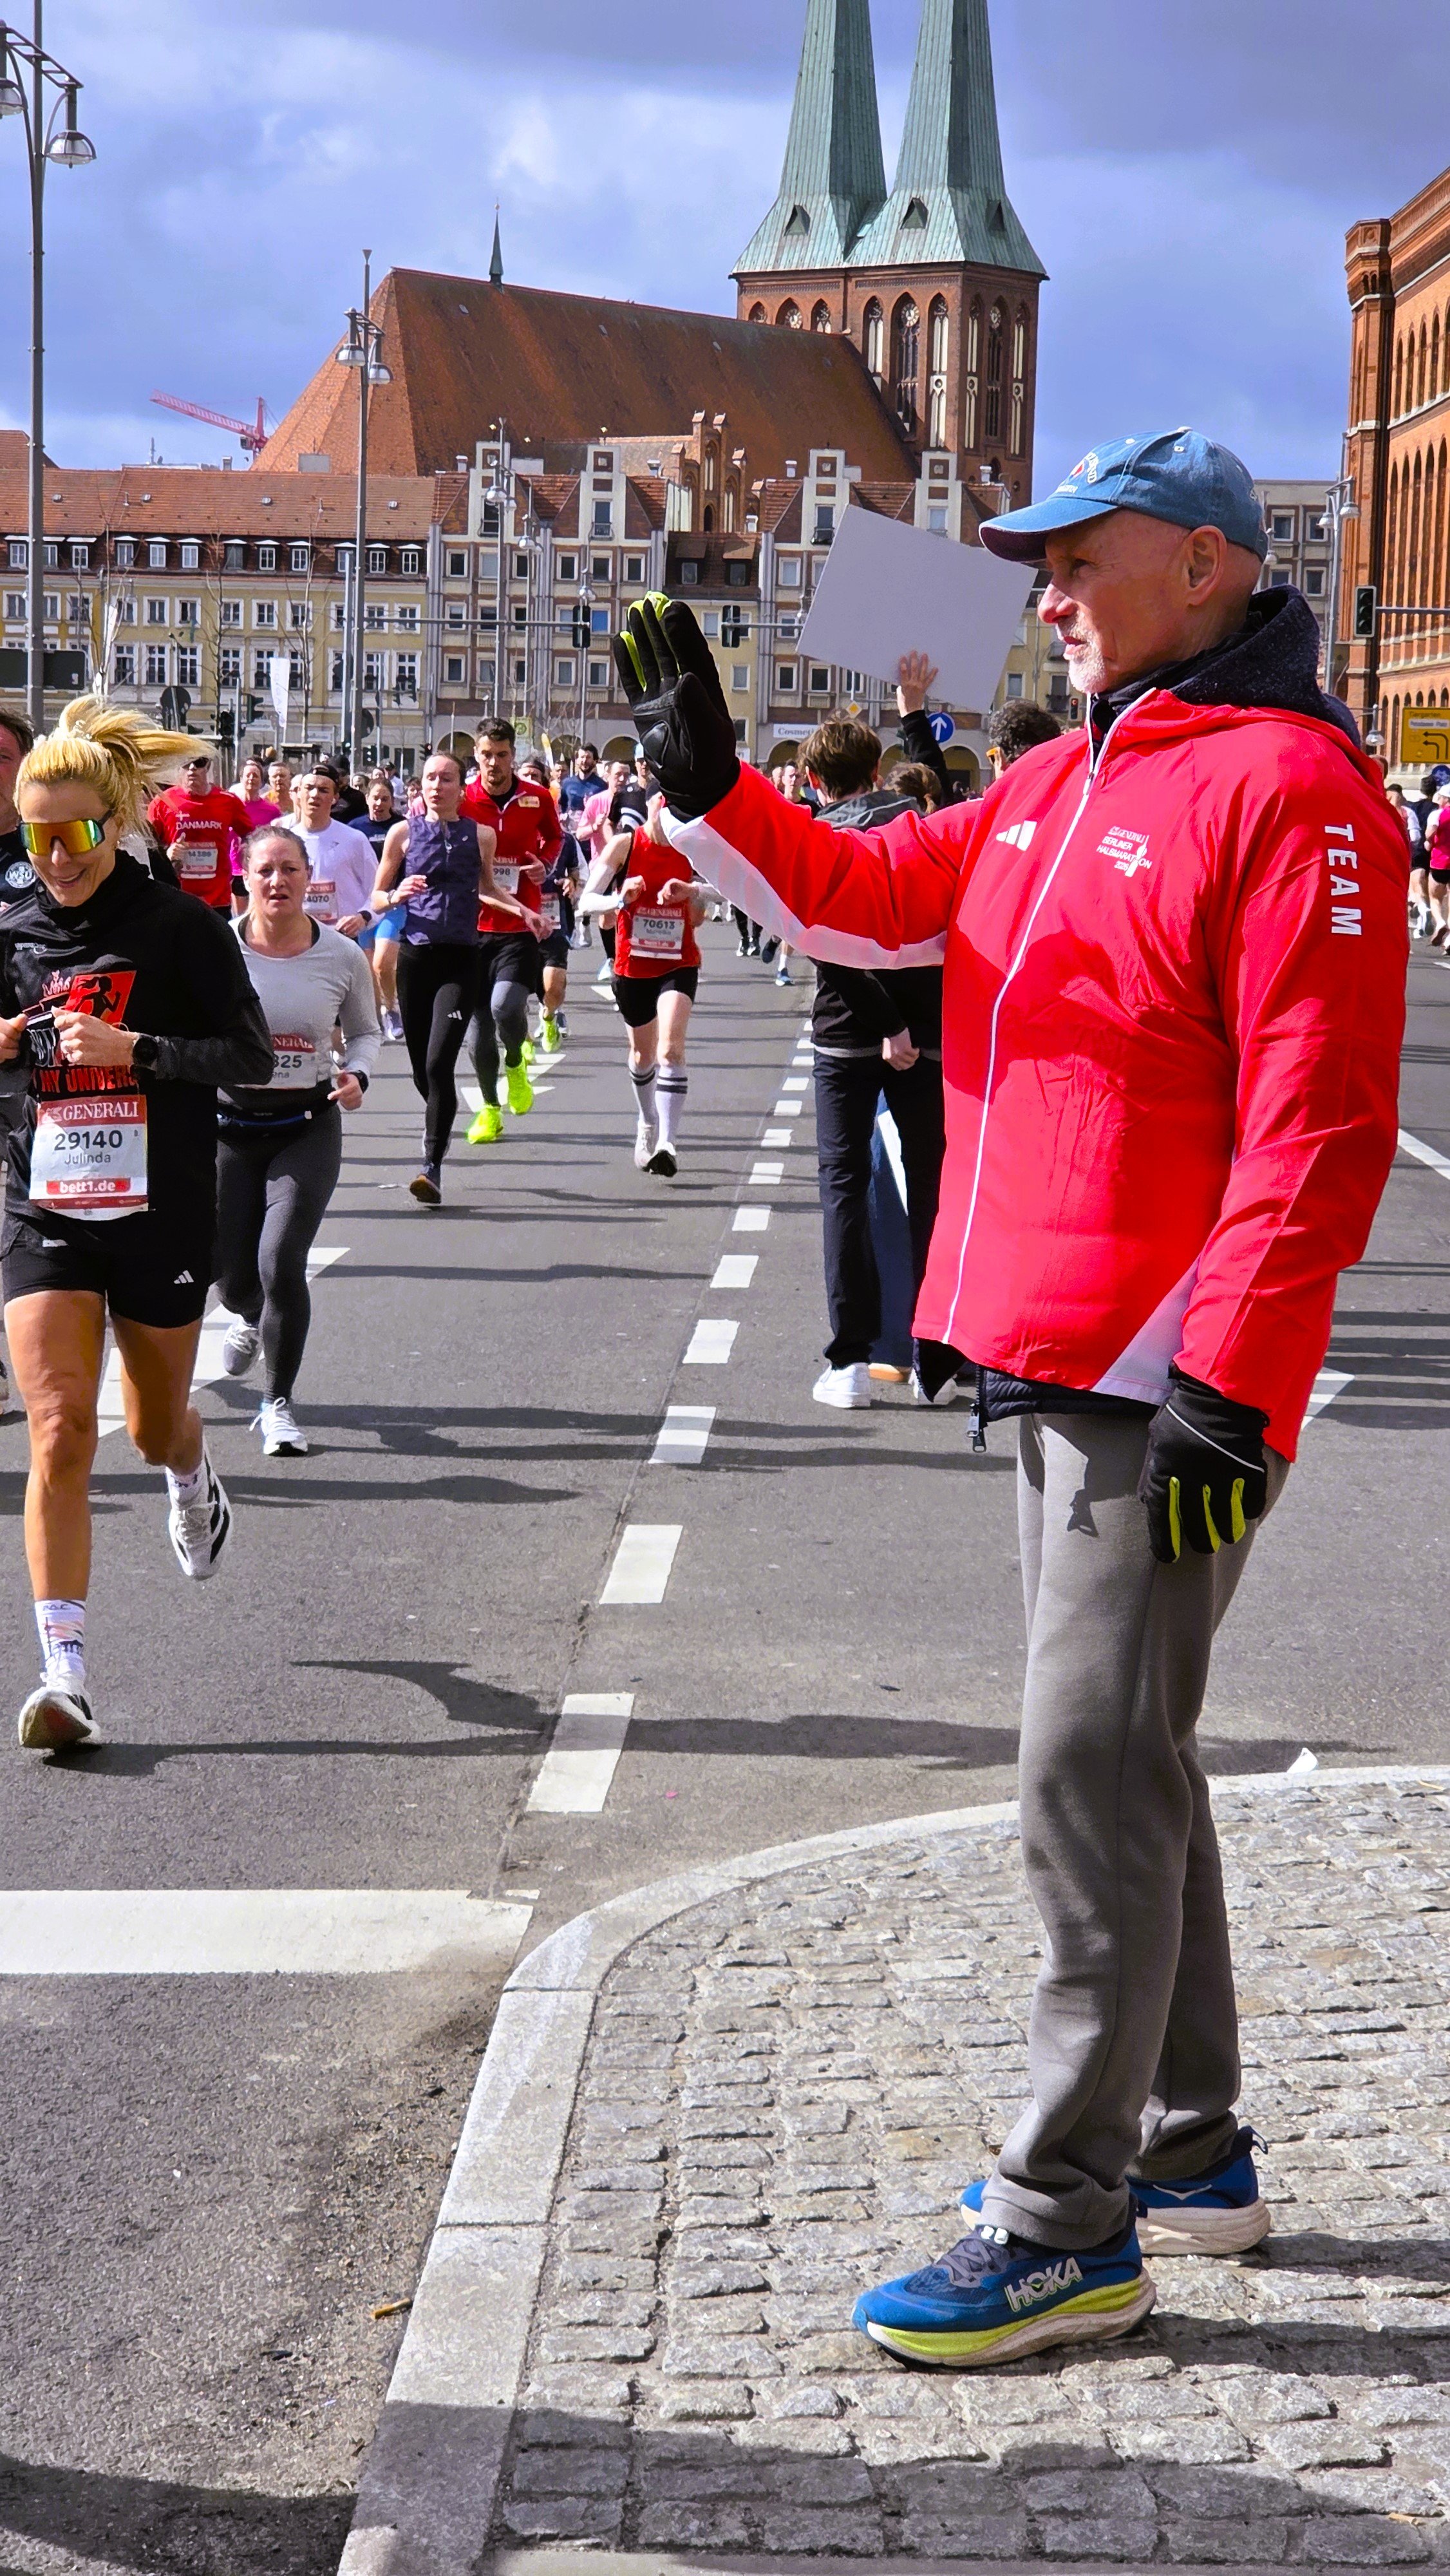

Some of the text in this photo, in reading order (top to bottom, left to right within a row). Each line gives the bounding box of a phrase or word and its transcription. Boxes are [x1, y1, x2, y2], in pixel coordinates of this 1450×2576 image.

[176, 820, 222, 830] DANMARK
[1324, 824, 1362, 936] TEAM
[643, 918, 675, 930] 70613
[62, 1101, 139, 1121] GENERALI
[54, 1130, 123, 1151] 29140
[64, 1151, 111, 1165] Julinda
[60, 1180, 116, 1193] bett1.de
[1004, 2256, 1083, 2313] HOKA
